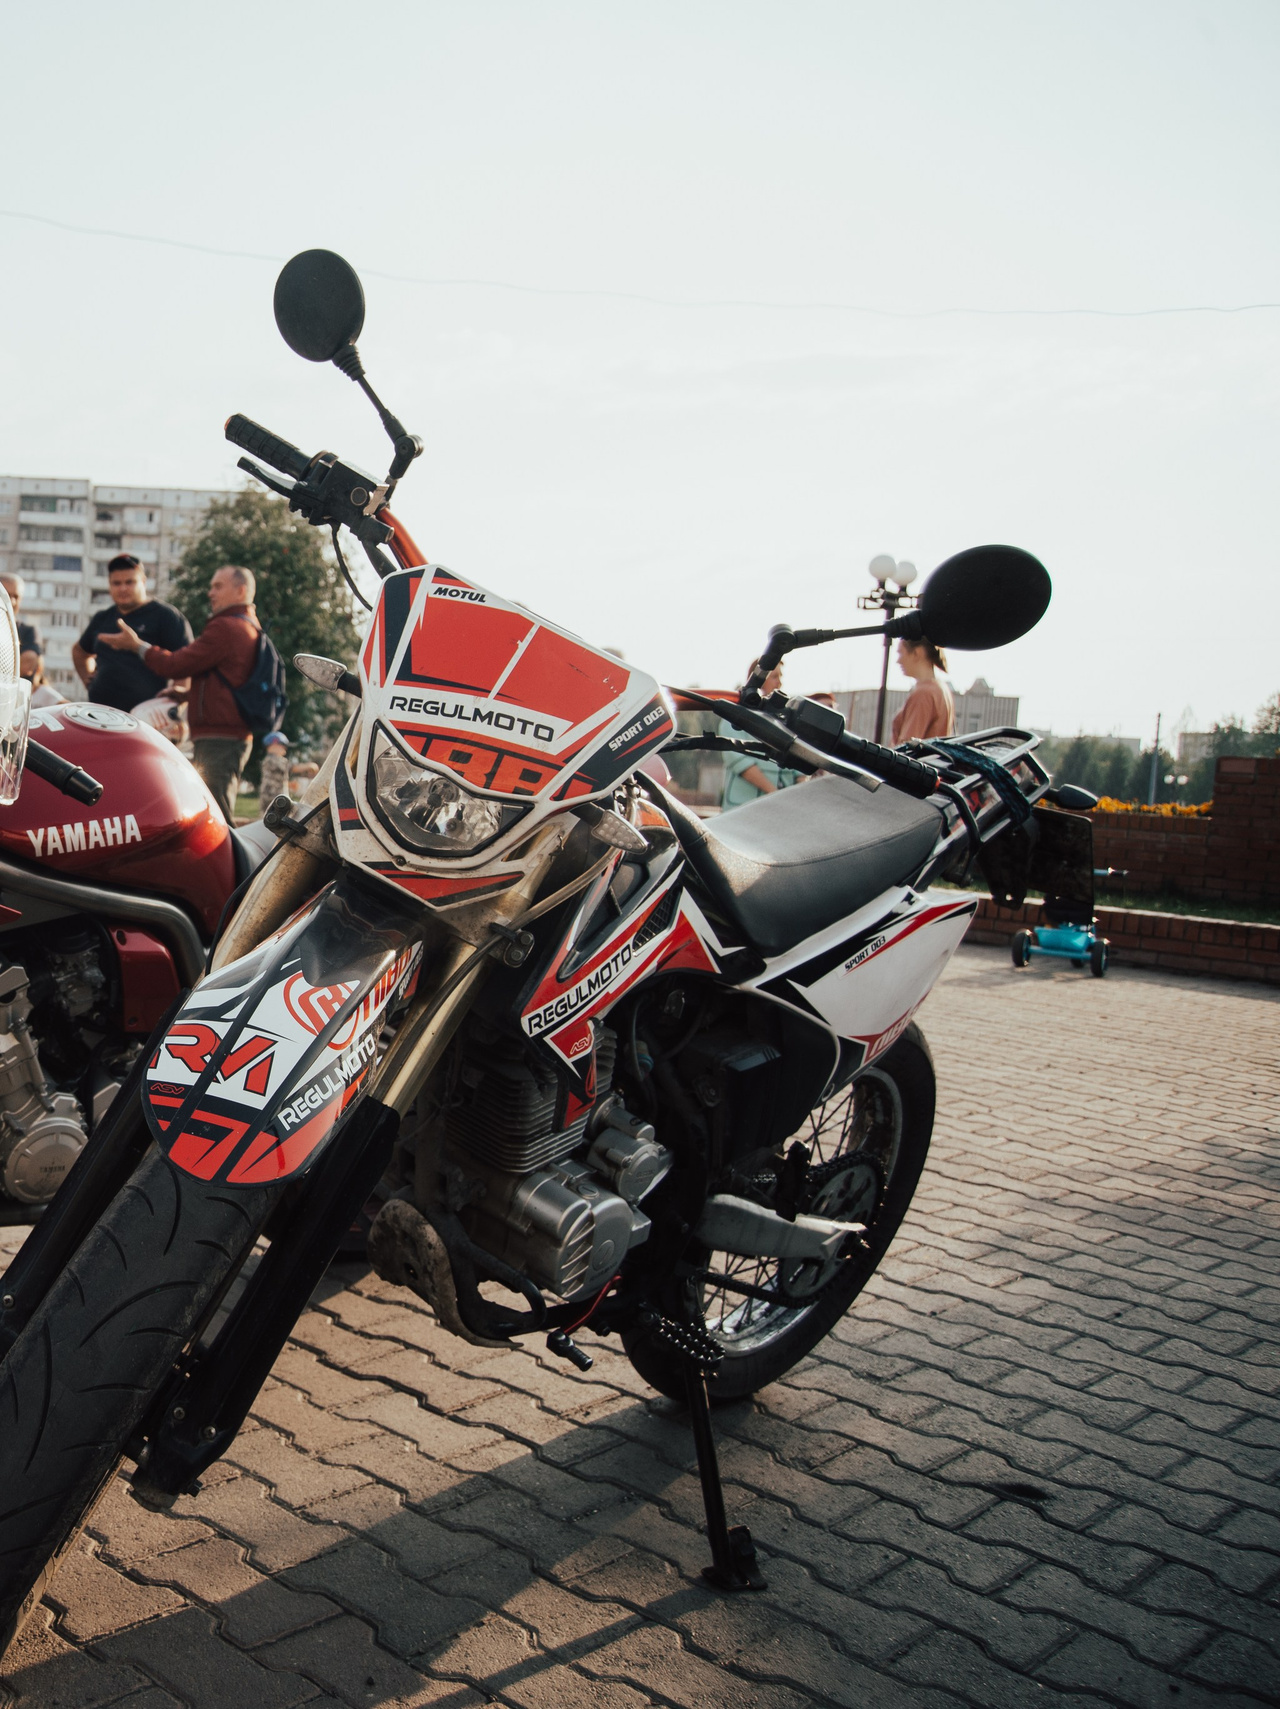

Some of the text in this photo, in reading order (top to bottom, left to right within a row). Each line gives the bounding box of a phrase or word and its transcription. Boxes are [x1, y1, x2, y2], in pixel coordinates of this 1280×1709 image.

[434, 586, 486, 603] MOTUL
[390, 696, 554, 742] REGULMOTO
[608, 706, 665, 752] SPORT 003
[26, 814, 142, 857] YAMAHA
[844, 935, 887, 972] SPORT 003
[528, 944, 632, 1035] REGULMOTO
[277, 1033, 376, 1131] REGULMOTO
